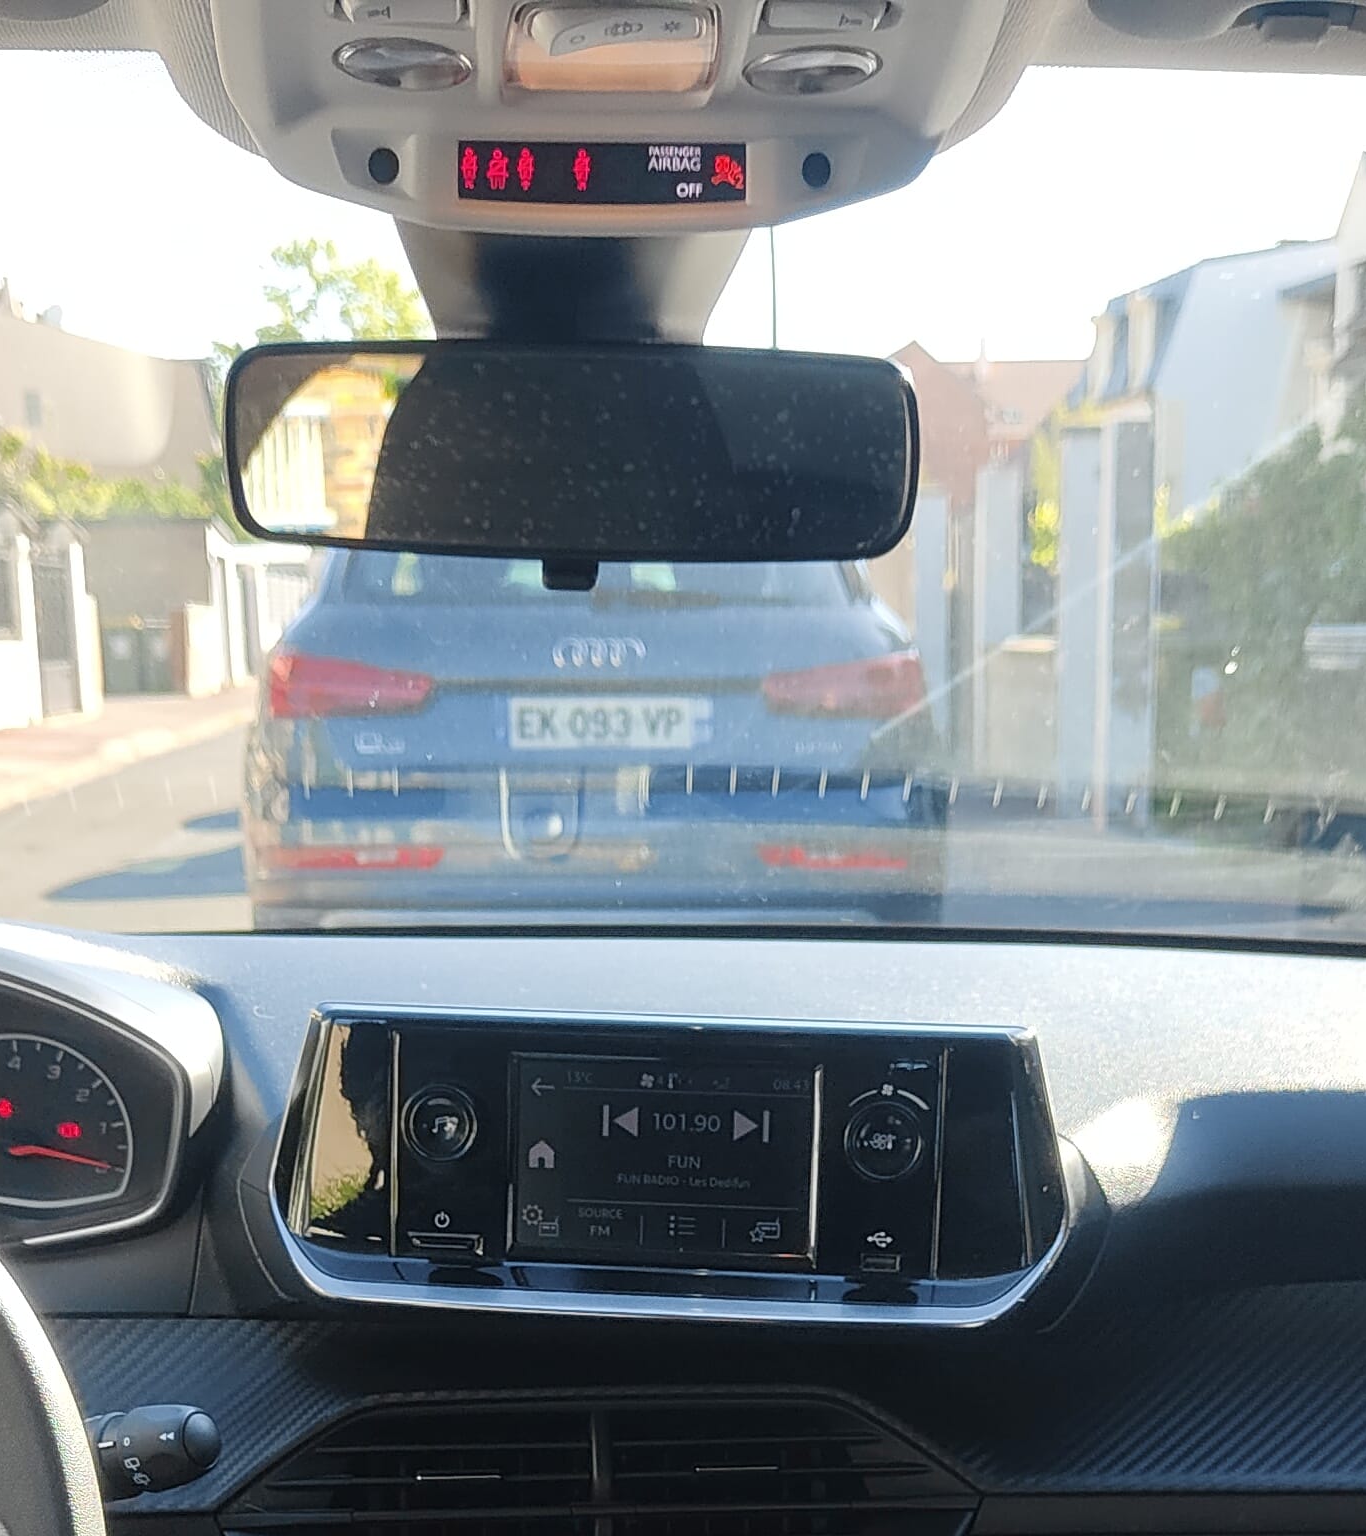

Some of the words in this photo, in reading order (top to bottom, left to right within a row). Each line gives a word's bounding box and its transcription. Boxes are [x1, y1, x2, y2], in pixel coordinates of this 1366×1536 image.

[648, 145, 701, 158] PASSENGER
[647, 157, 701, 172] AIRBAG
[676, 183, 702, 198] OFF
[517, 705, 557, 740] EK
[569, 706, 632, 740] 093
[642, 707, 683, 740] VP
[8, 1057, 21, 1070] 4
[47, 1064, 61, 1080] 3
[75, 1088, 90, 1102] 2
[653, 1112, 722, 1133] 101.90
[667, 1155, 702, 1170] FUN
[617, 1173, 641, 1185] FUN
[643, 1174, 680, 1187] RADIO
[578, 1207, 623, 1220] SOURCE
[589, 1225, 610, 1238] FM
